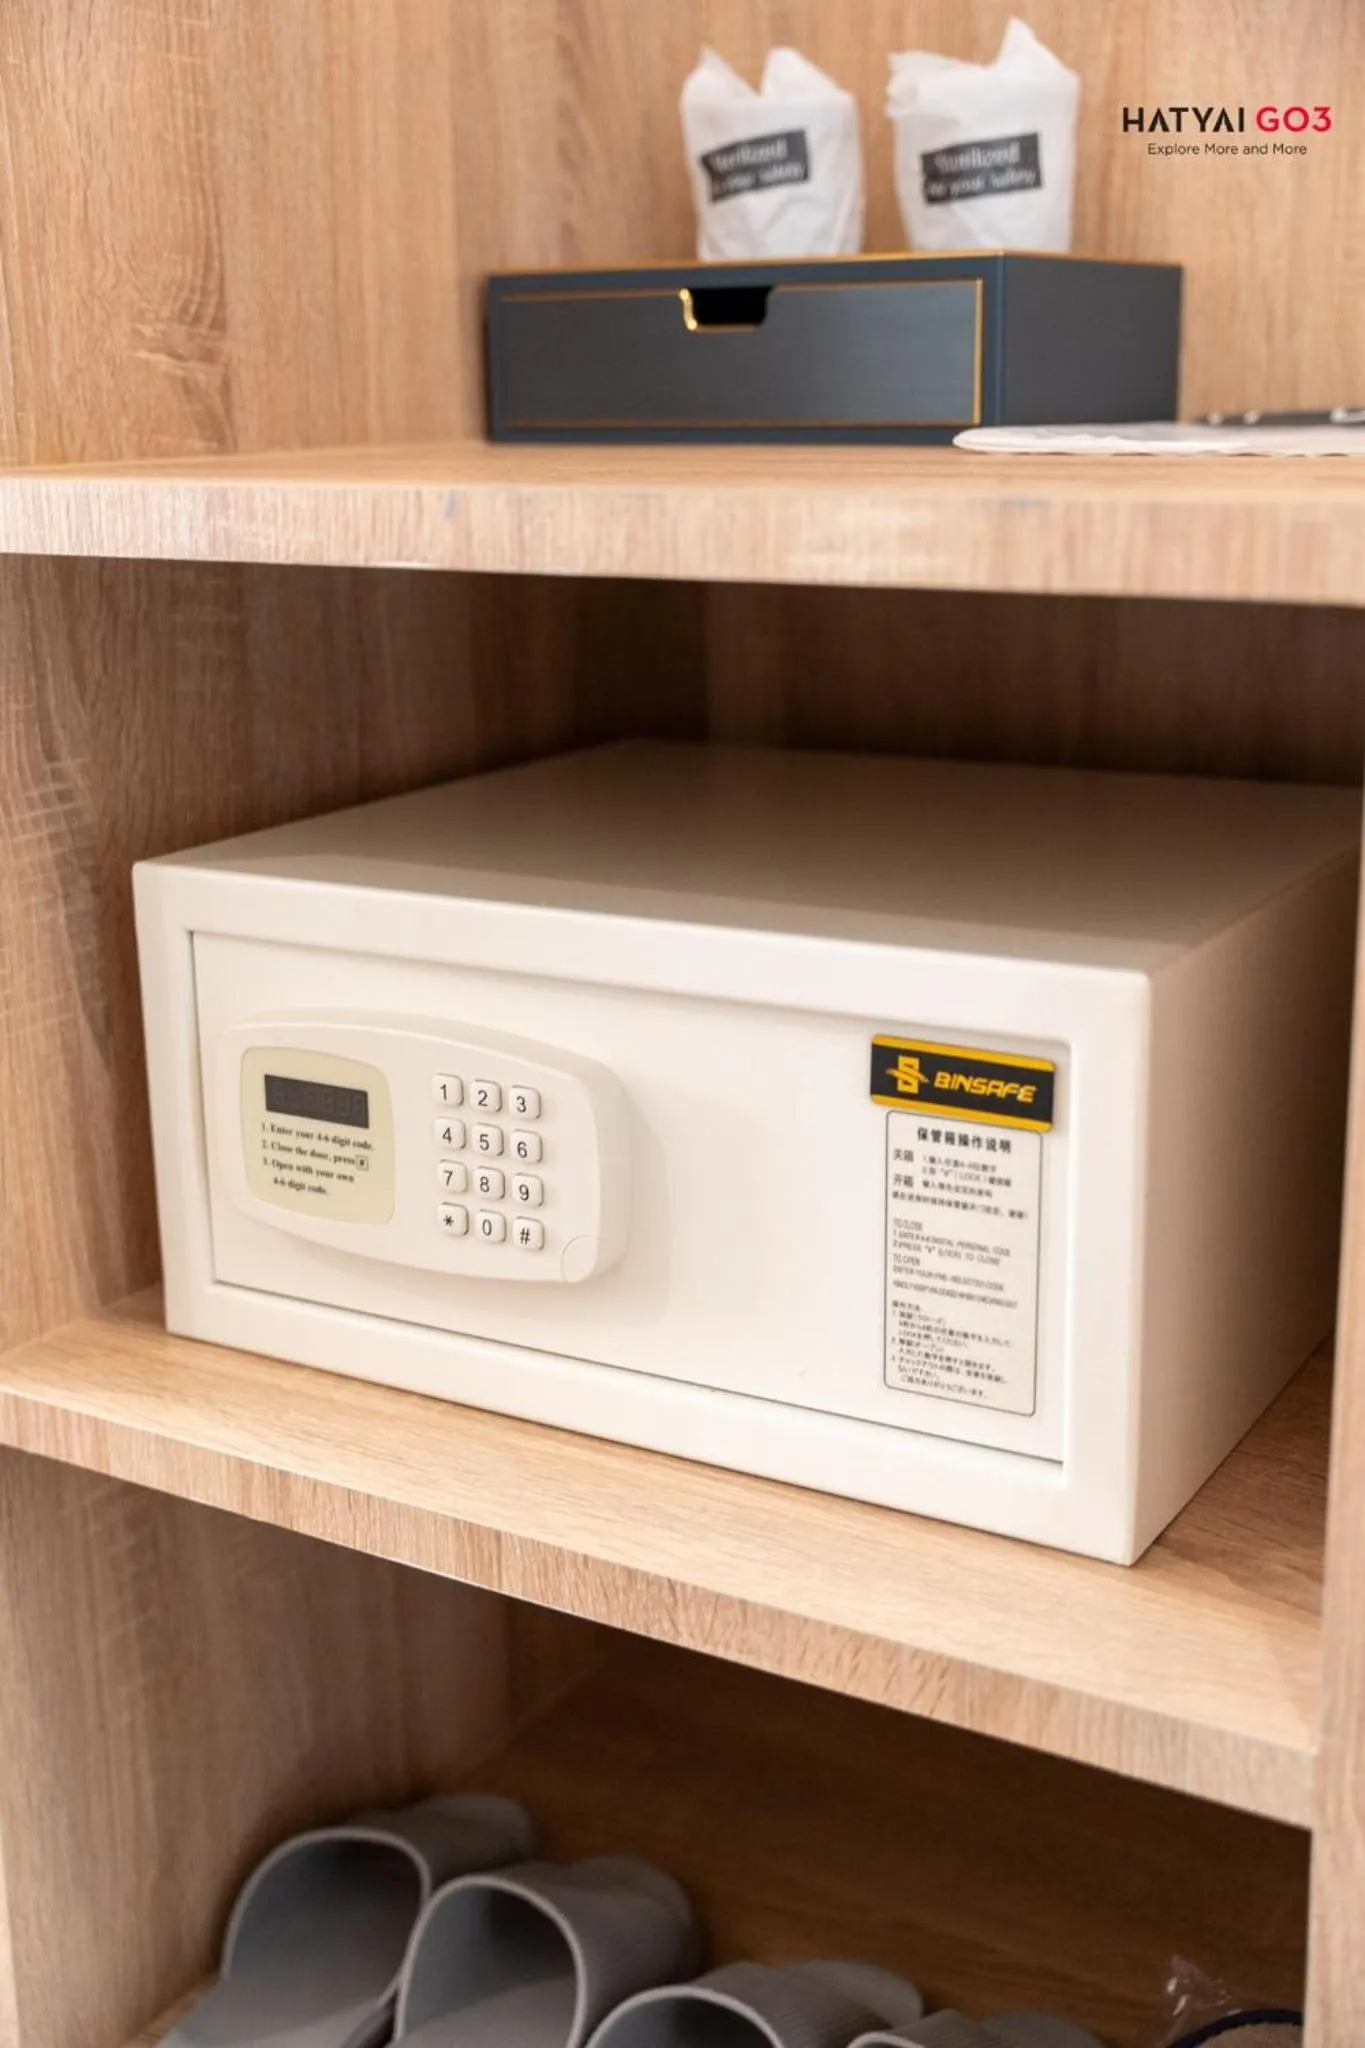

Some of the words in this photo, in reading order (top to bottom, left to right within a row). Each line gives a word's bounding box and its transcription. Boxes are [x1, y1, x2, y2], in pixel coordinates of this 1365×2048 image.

[440, 1084, 447, 1100] 1
[478, 1090, 488, 1107] 2
[516, 1096, 527, 1113] 3
[933, 1071, 1037, 1104] BINSAFE
[442, 1128, 452, 1144] 4
[479, 1134, 490, 1151] 5
[517, 1141, 528, 1158] 6
[917, 1126, 1011, 1153] 保管箱操作说明
[443, 1170, 453, 1187] 7
[480, 1176, 490, 1193] 8
[519, 1184, 529, 1201] 9
[482, 1219, 492, 1236] 0
[520, 1227, 531, 1245] #
